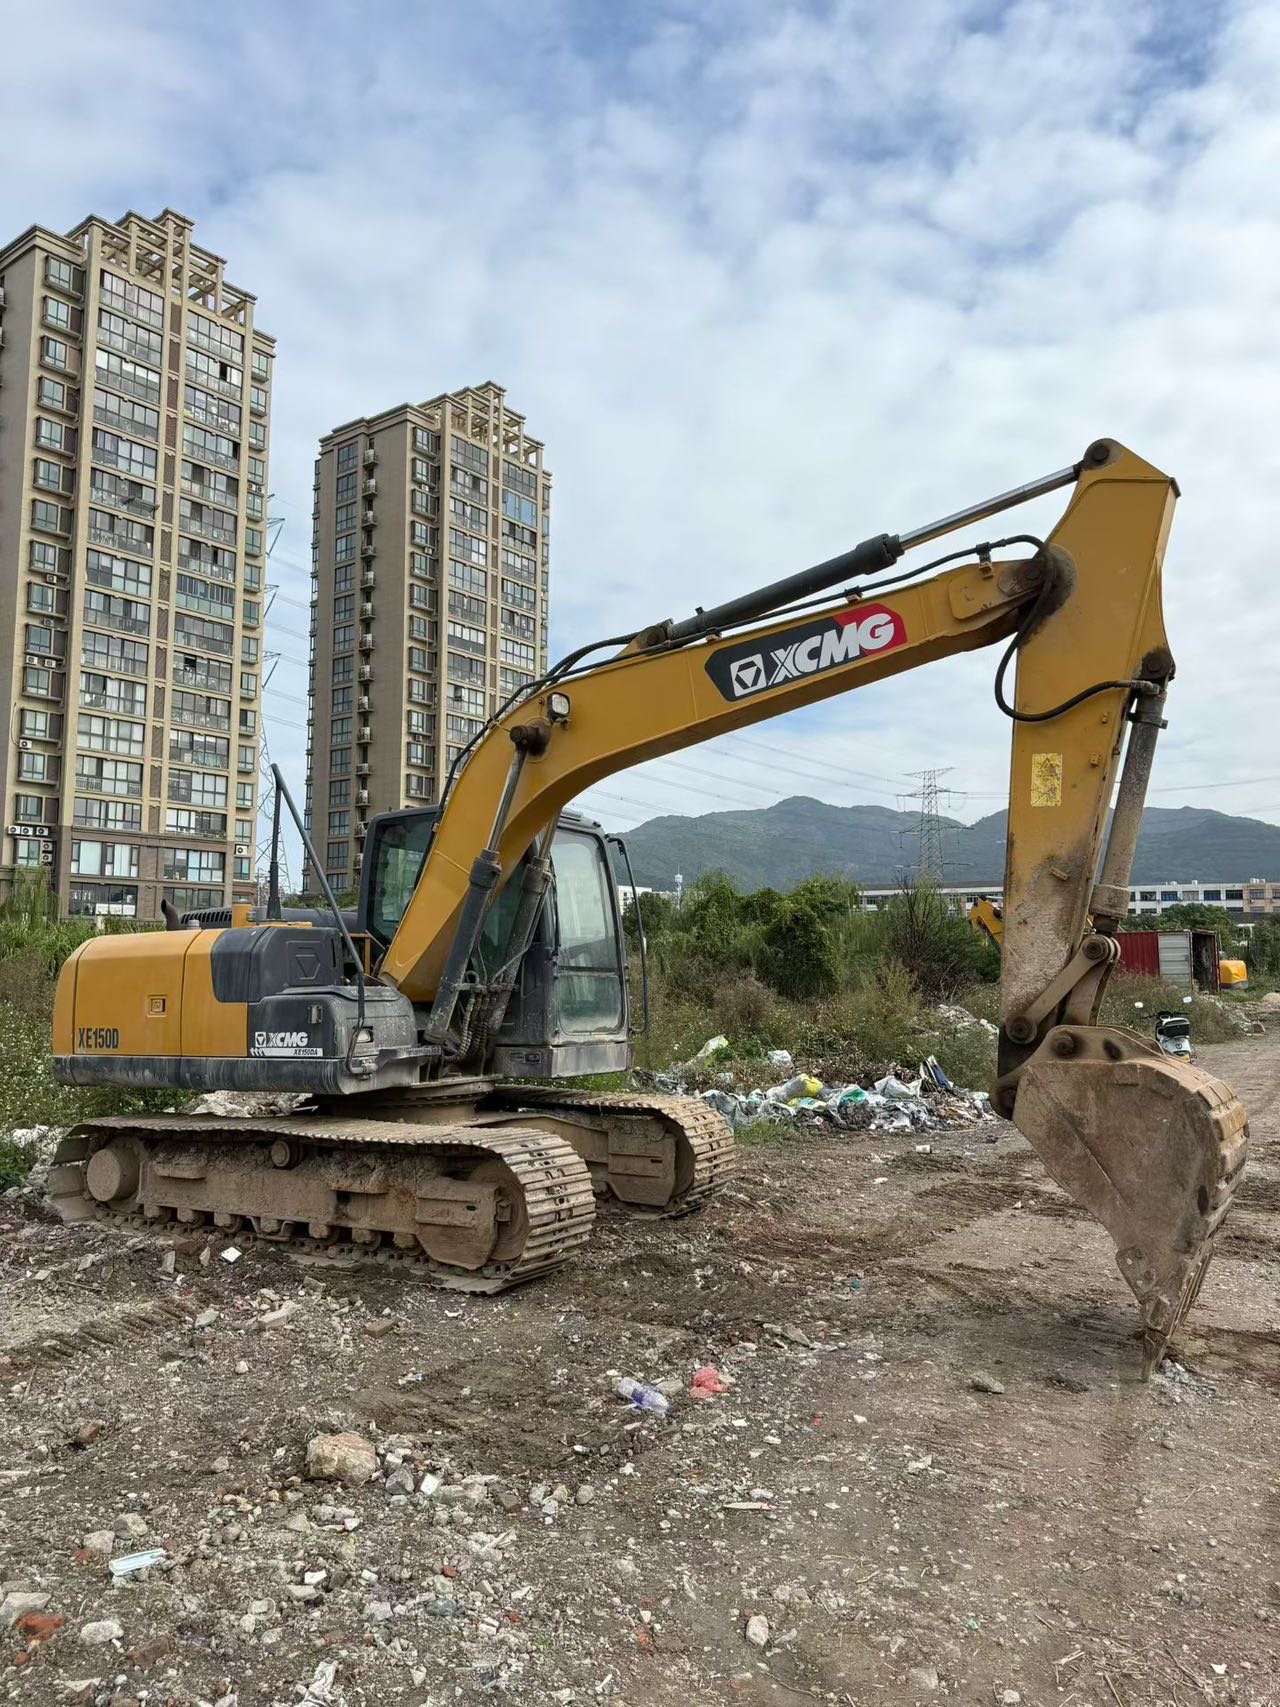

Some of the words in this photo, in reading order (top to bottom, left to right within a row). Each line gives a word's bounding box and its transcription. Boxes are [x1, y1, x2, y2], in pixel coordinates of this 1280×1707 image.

[768, 613, 894, 686] XCMG
[78, 1027, 119, 1049] XE150D
[267, 1031, 308, 1048] XCMG
